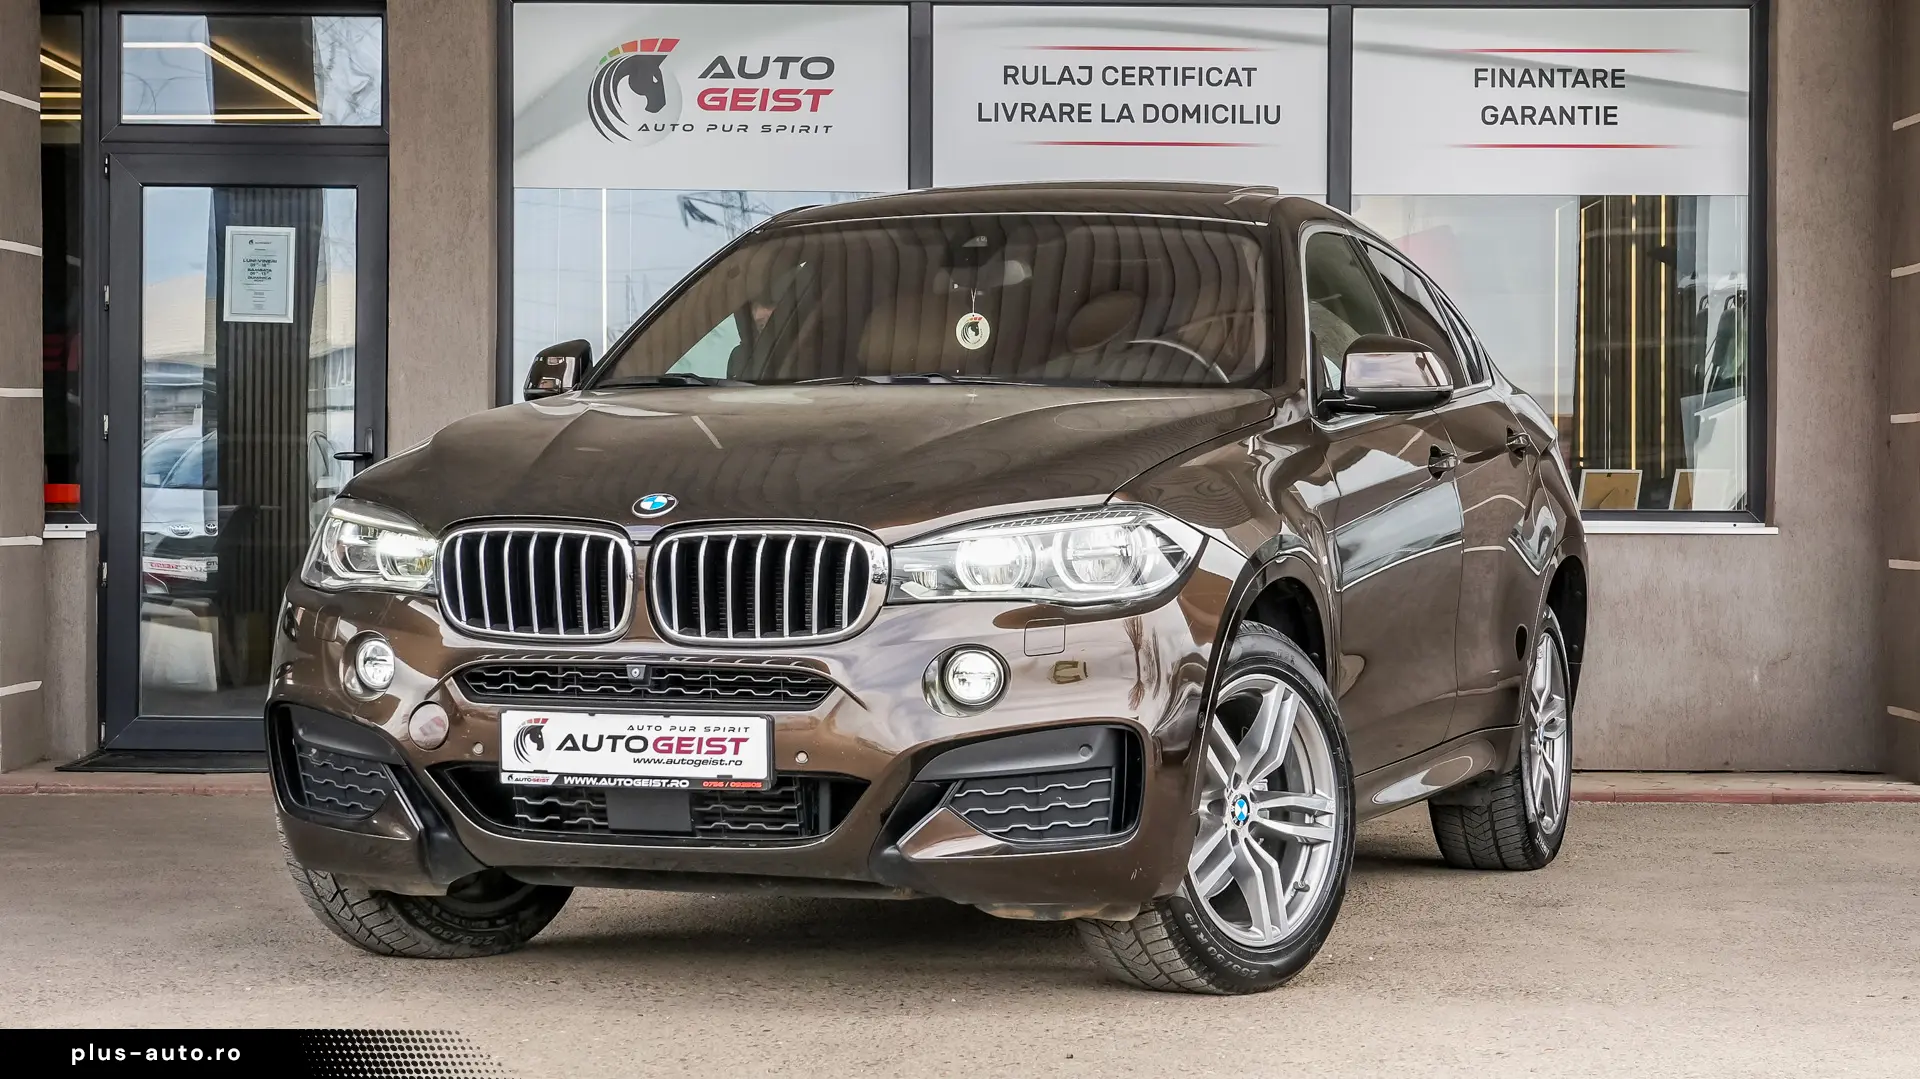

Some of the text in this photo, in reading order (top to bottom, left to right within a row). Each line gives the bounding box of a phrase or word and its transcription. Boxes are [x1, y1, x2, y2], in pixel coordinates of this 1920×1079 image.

[697, 55, 835, 80] AUTO
[1003, 65, 1257, 87] RULAJ CERTIFICAT
[1474, 68, 1626, 88] FINANTARE
[697, 88, 834, 112] GEIST
[977, 102, 1281, 125] LIVRARE LA DOMICILIU
[1481, 105, 1618, 126] GARANTIE
[637, 123, 834, 134] AUTO PUR SPIRIT
[633, 757, 743, 767] www.autogeist.ro
[563, 776, 690, 788] WWW.AUTOGEIST.RO
